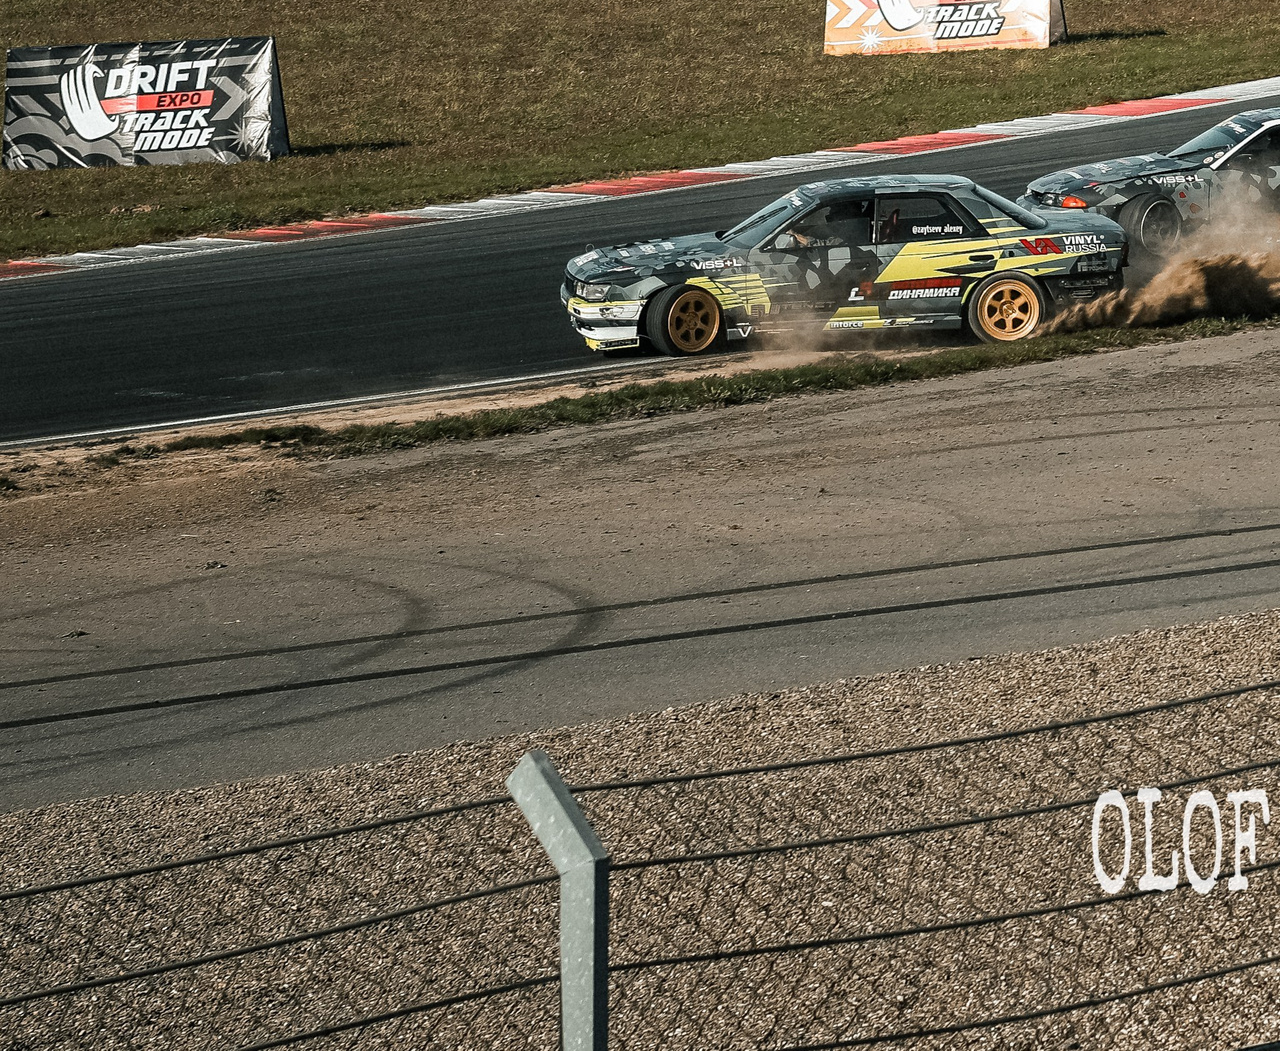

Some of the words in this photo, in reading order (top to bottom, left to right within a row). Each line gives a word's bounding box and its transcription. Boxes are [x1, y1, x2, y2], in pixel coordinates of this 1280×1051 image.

[925, 5, 999, 23] TRACK
[934, 18, 1004, 39] MODE
[104, 59, 216, 97] DRIFT
[156, 93, 201, 107] EXPO
[122, 108, 210, 133] TRACK
[133, 127, 216, 151] MODE
[1153, 174, 1204, 184] VISS+L
[912, 223, 963, 235] @zaytsevv_alexey
[1065, 243, 1107, 254] RUSSIA
[692, 258, 742, 270] VISS+L
[888, 287, 961, 300] ДИНАМИКА
